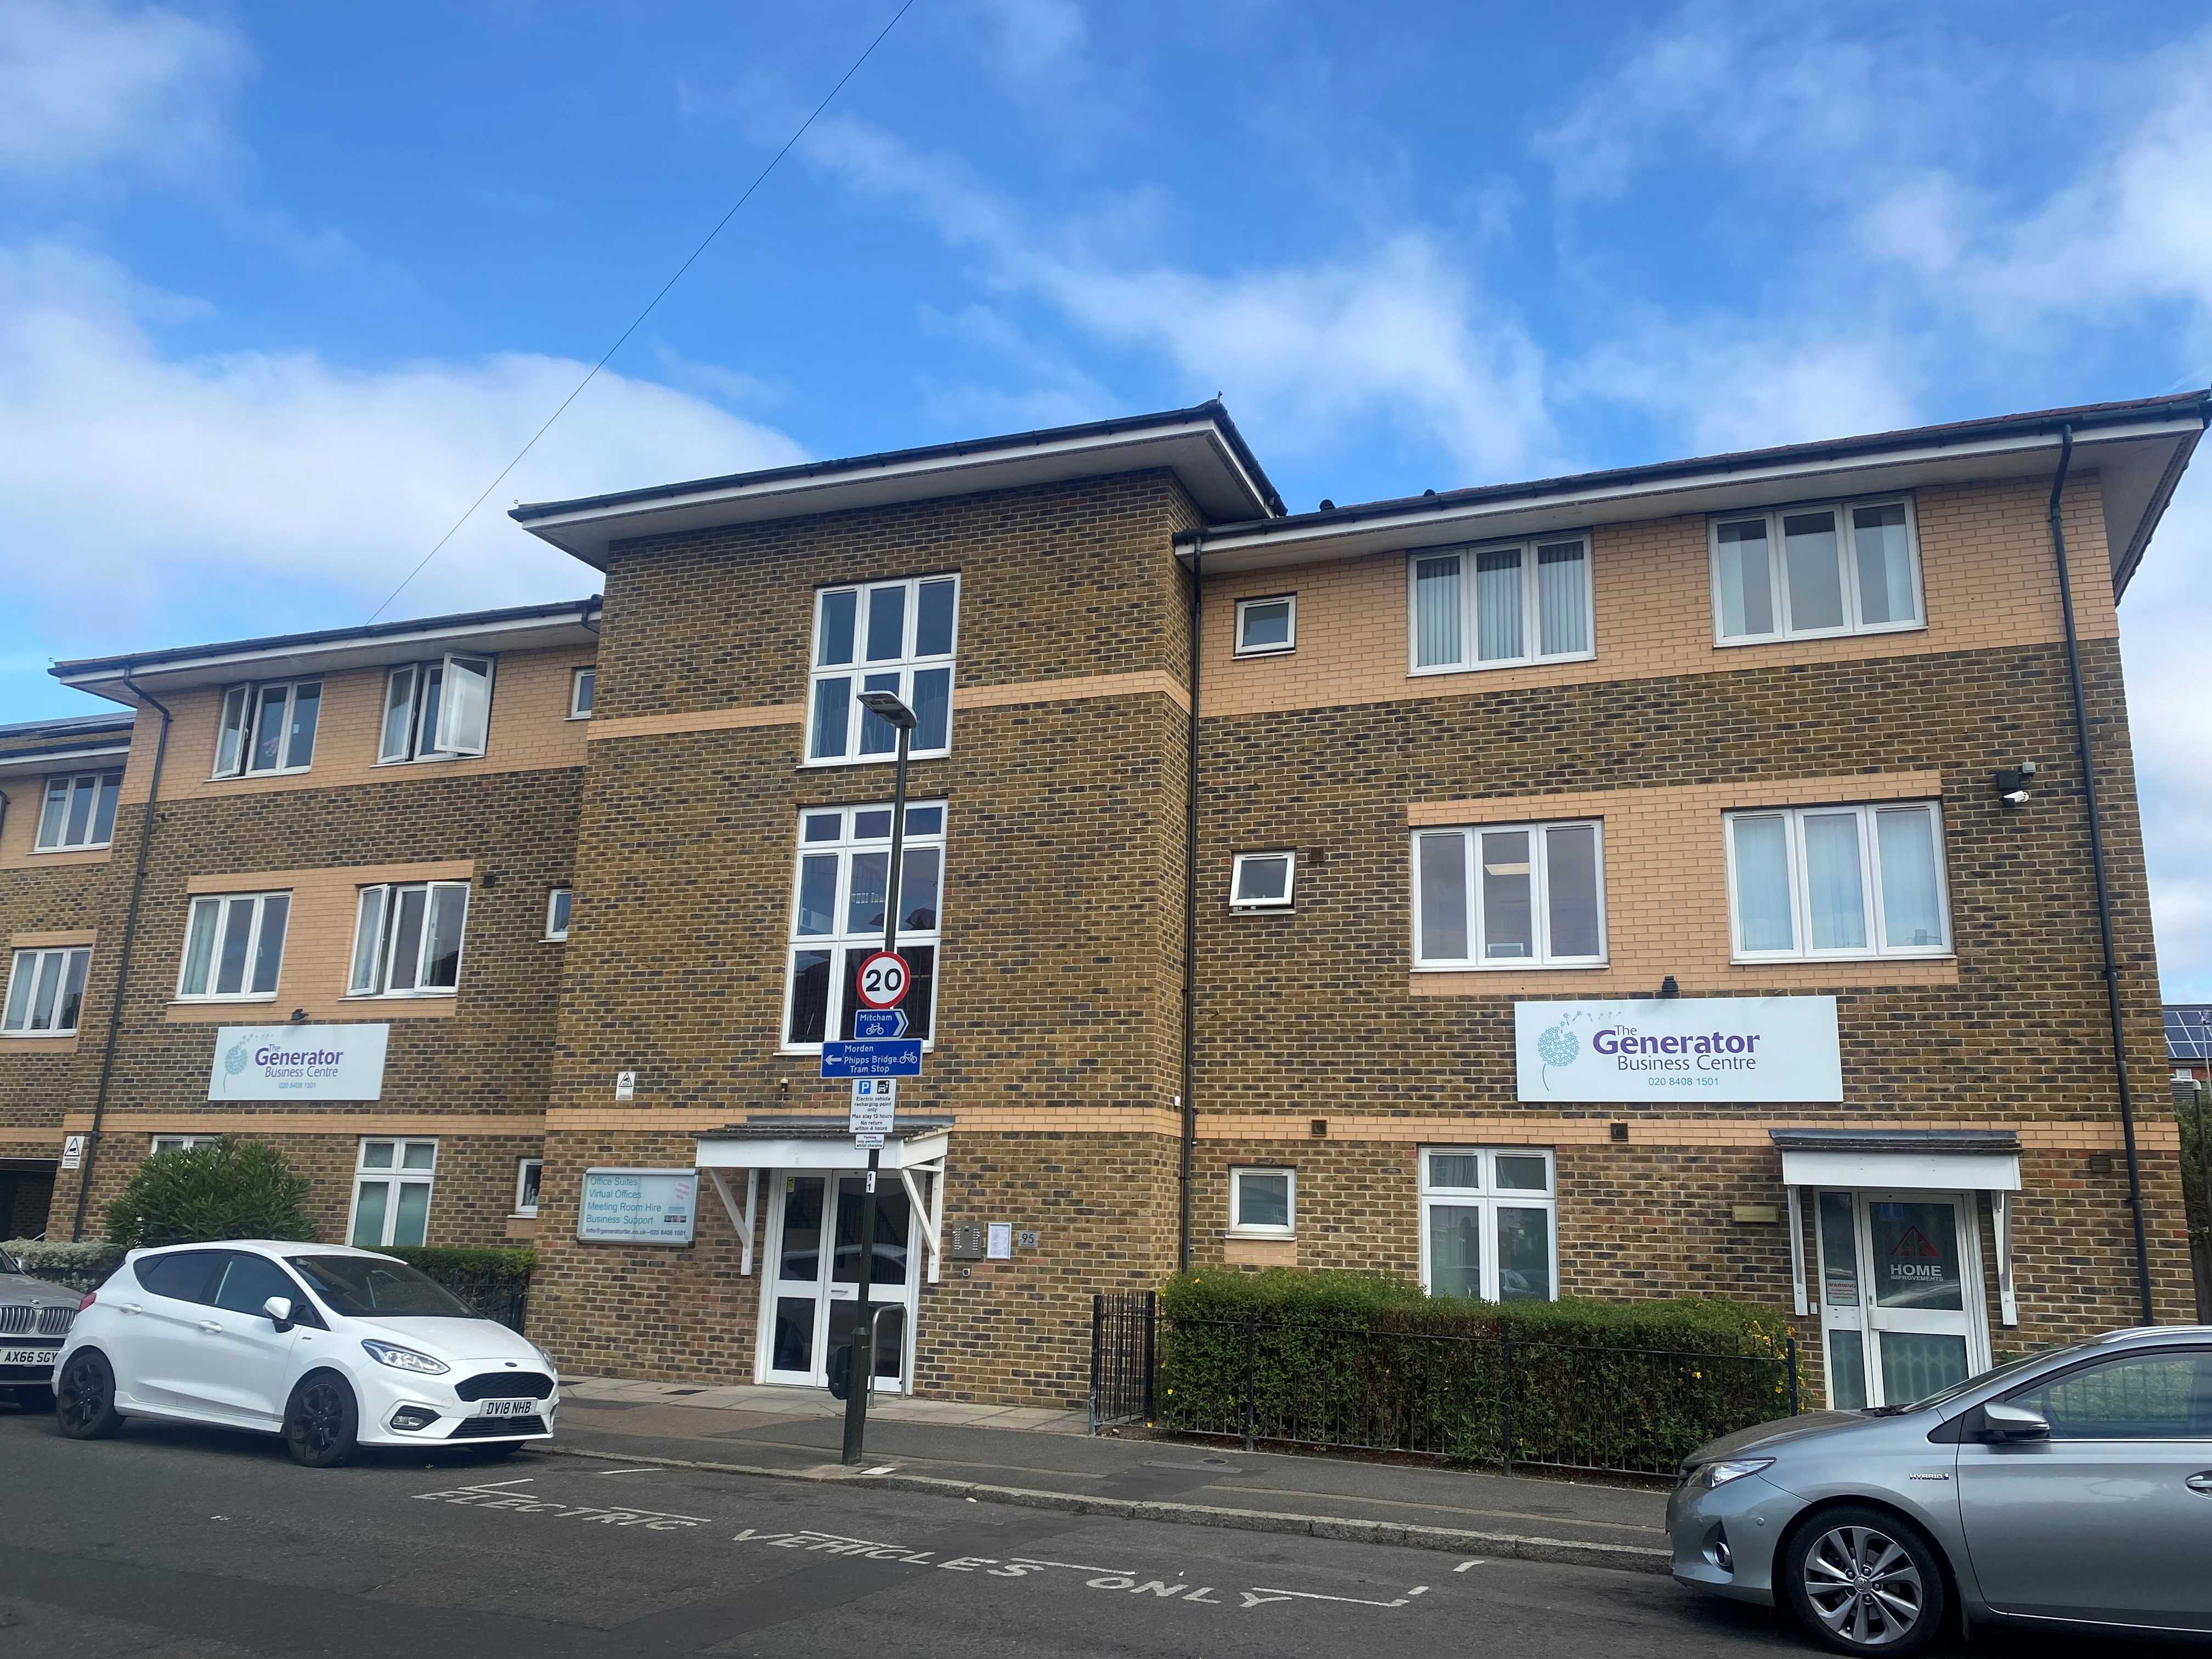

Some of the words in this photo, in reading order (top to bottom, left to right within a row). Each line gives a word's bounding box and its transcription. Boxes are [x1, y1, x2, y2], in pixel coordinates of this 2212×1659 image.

[866, 968, 901, 992] 20
[1614, 1025, 1637, 1035] The
[1593, 1030, 1760, 1054] Generator
[268, 1044, 281, 1052] The
[255, 1048, 343, 1065] Generator
[844, 1056, 869, 1065] Phipps
[872, 1056, 898, 1064] Bridge
[1618, 1055, 1690, 1070] Business
[1697, 1054, 1756, 1070] Centre
[265, 1066, 303, 1077] Business
[307, 1066, 338, 1077] Centre
[871, 1064, 890, 1073] Stop
[1648, 1077, 1666, 1086] 020
[1669, 1077, 1692, 1086] 8408
[1697, 1077, 1719, 1086] 1501
[861, 1082, 869, 1093] P
[590, 1176, 612, 1185] Office
[614, 1177, 637, 1186] Suites
[589, 1189, 613, 1198] Virtual
[614, 1189, 641, 1198] Offices
[588, 1202, 618, 1212] Meeting
[620, 1203, 642, 1211] Room
[645, 1203, 662, 1211] Hire
[586, 1215, 620, 1223] Business
[623, 1216, 653, 1226] Support
[1022, 1233, 1034, 1244] 95
[1891, 1264, 1942, 1276] HOME
[4, 1352, 35, 1362] AX66
[36, 1352, 58, 1363] SGY
[487, 1402, 510, 1414] DV18
[511, 1401, 531, 1414] NHB
[410, 1491, 697, 1530] ELECTRIC
[732, 1529, 1045, 1577] VEHICLES
[1086, 1577, 1293, 1607] ONLY
